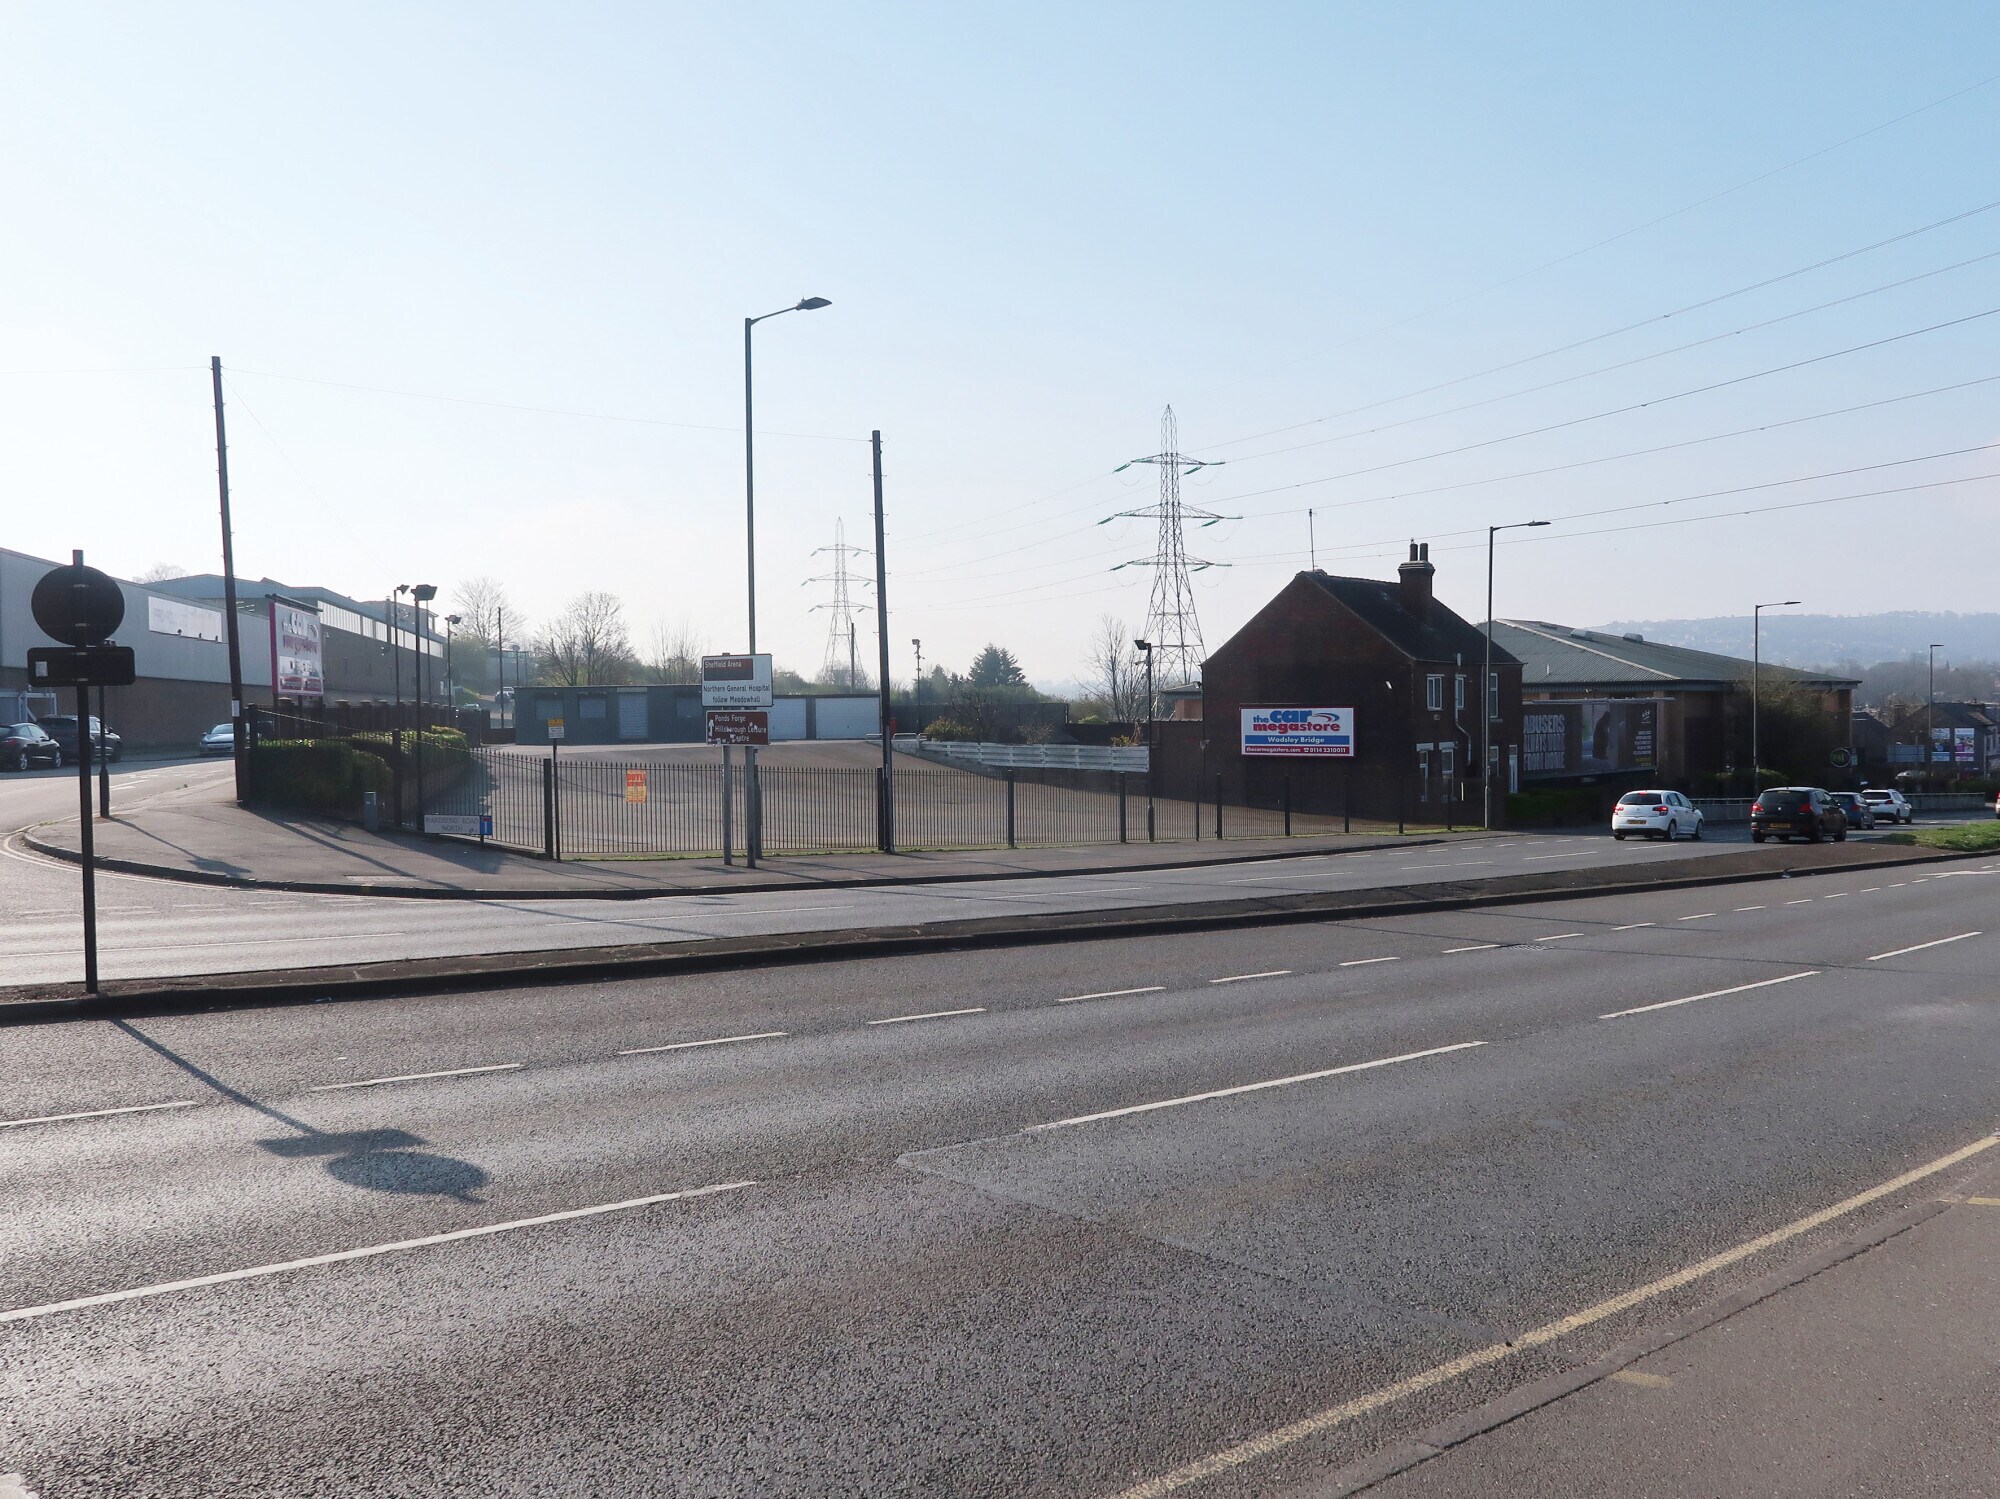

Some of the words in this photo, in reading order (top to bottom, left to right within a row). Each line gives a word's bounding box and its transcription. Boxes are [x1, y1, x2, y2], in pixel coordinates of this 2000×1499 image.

[704, 661, 726, 669] Sheffield
[703, 685, 726, 693] Northern
[726, 684, 747, 692] General
[748, 684, 771, 693] Hospital
[731, 714, 746, 723] Forge
[1252, 715, 1270, 723] the
[1269, 710, 1313, 723] car
[1252, 722, 1341, 734] megastore
[1523, 714, 1565, 734] ABUSERS
[1267, 736, 1299, 744] Wadsley
[1300, 736, 1325, 744] Bridge
[462, 816, 479, 824] ROAD
